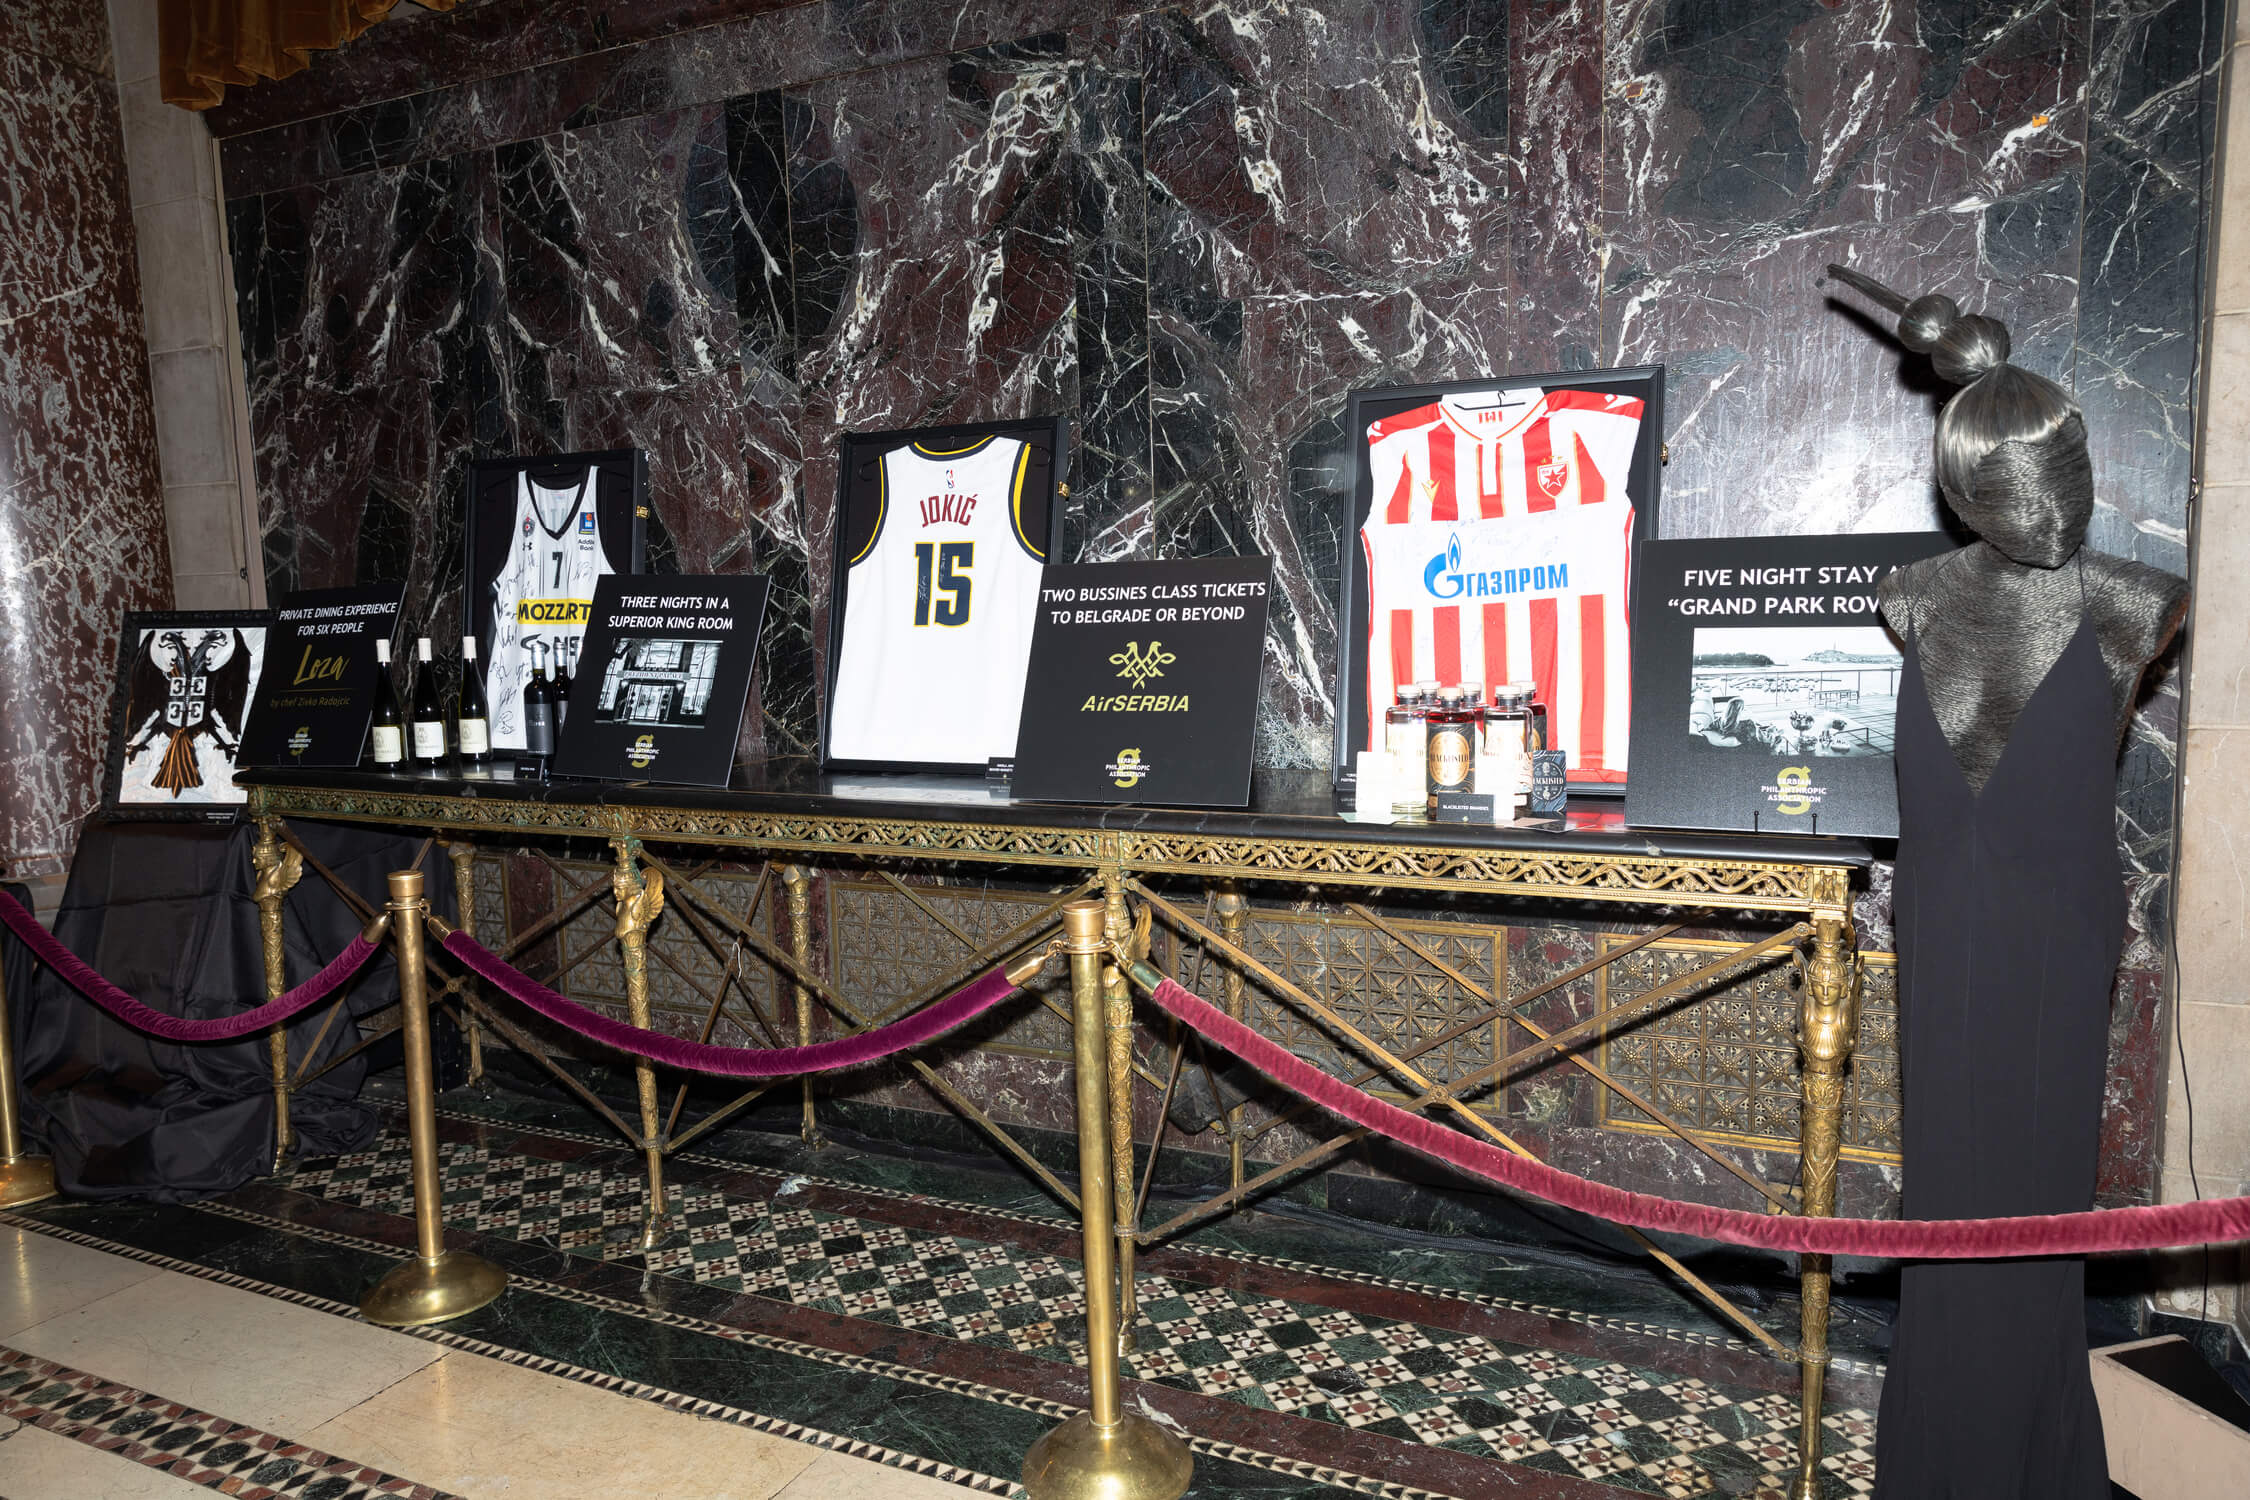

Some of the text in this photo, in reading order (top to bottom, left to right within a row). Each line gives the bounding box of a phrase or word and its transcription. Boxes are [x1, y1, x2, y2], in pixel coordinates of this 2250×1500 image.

[920, 494, 978, 528] JOKIĆ
[552, 552, 563, 588] 7
[1684, 569, 1733, 587] FIVE
[1740, 567, 1811, 585] NIGHT
[1818, 566, 1879, 584] STAY
[914, 541, 975, 627] 15
[1466, 563, 1569, 598] ГАЗПРОМ
[1042, 582, 1266, 603] TWO BUSSINES CLASS TICKETS
[279, 602, 398, 621] PRIVATE DINING EXPERIENCE
[621, 596, 730, 610] THREE NIGHTS IN A
[1765, 597, 1825, 615] PARK
[608, 615, 733, 630] SUPERIOR KING ROOM
[1051, 606, 1245, 624] TO BELGRADE OR BEYOND
[297, 622, 365, 636] FOR SIX PEOPLE
[1080, 695, 1190, 712] AirSERBIA
[1532, 777, 1564, 785] LACKLISTED
[1761, 785, 1827, 795] PHILANTHROPIC
